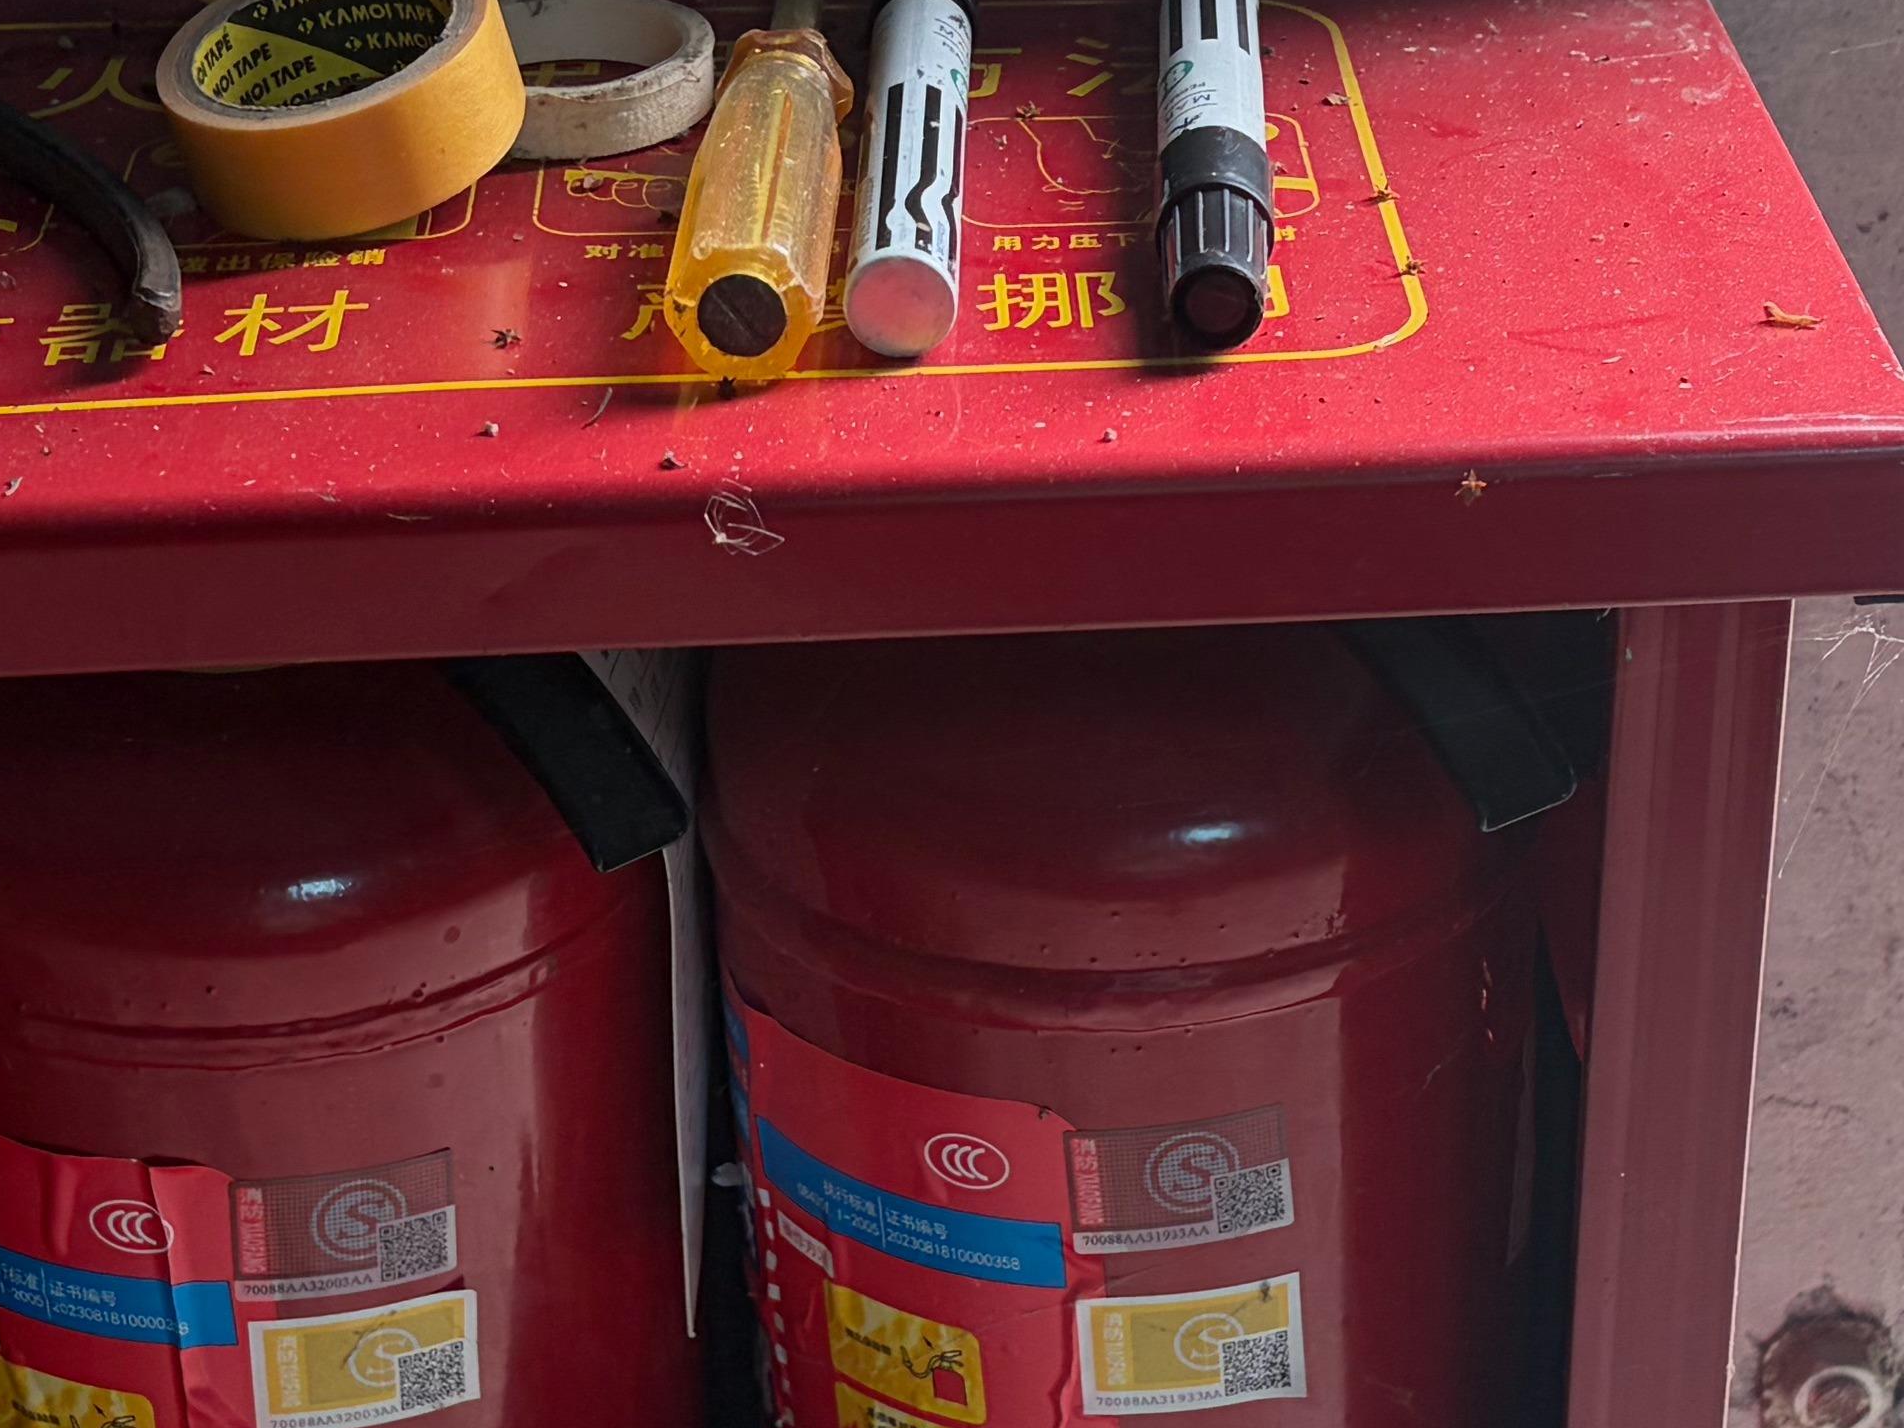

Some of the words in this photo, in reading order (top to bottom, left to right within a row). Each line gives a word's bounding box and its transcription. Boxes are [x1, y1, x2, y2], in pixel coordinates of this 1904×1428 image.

[318, 3, 393, 29] KAMOI
[395, 2, 435, 23] TAPE
[204, 33, 234, 71] TAPE
[233, 42, 273, 79] TAPE
[271, 55, 317, 89] TAPE
[885, 1208, 949, 1241] 证书编号
[49, 1281, 118, 1308] 证书编号
